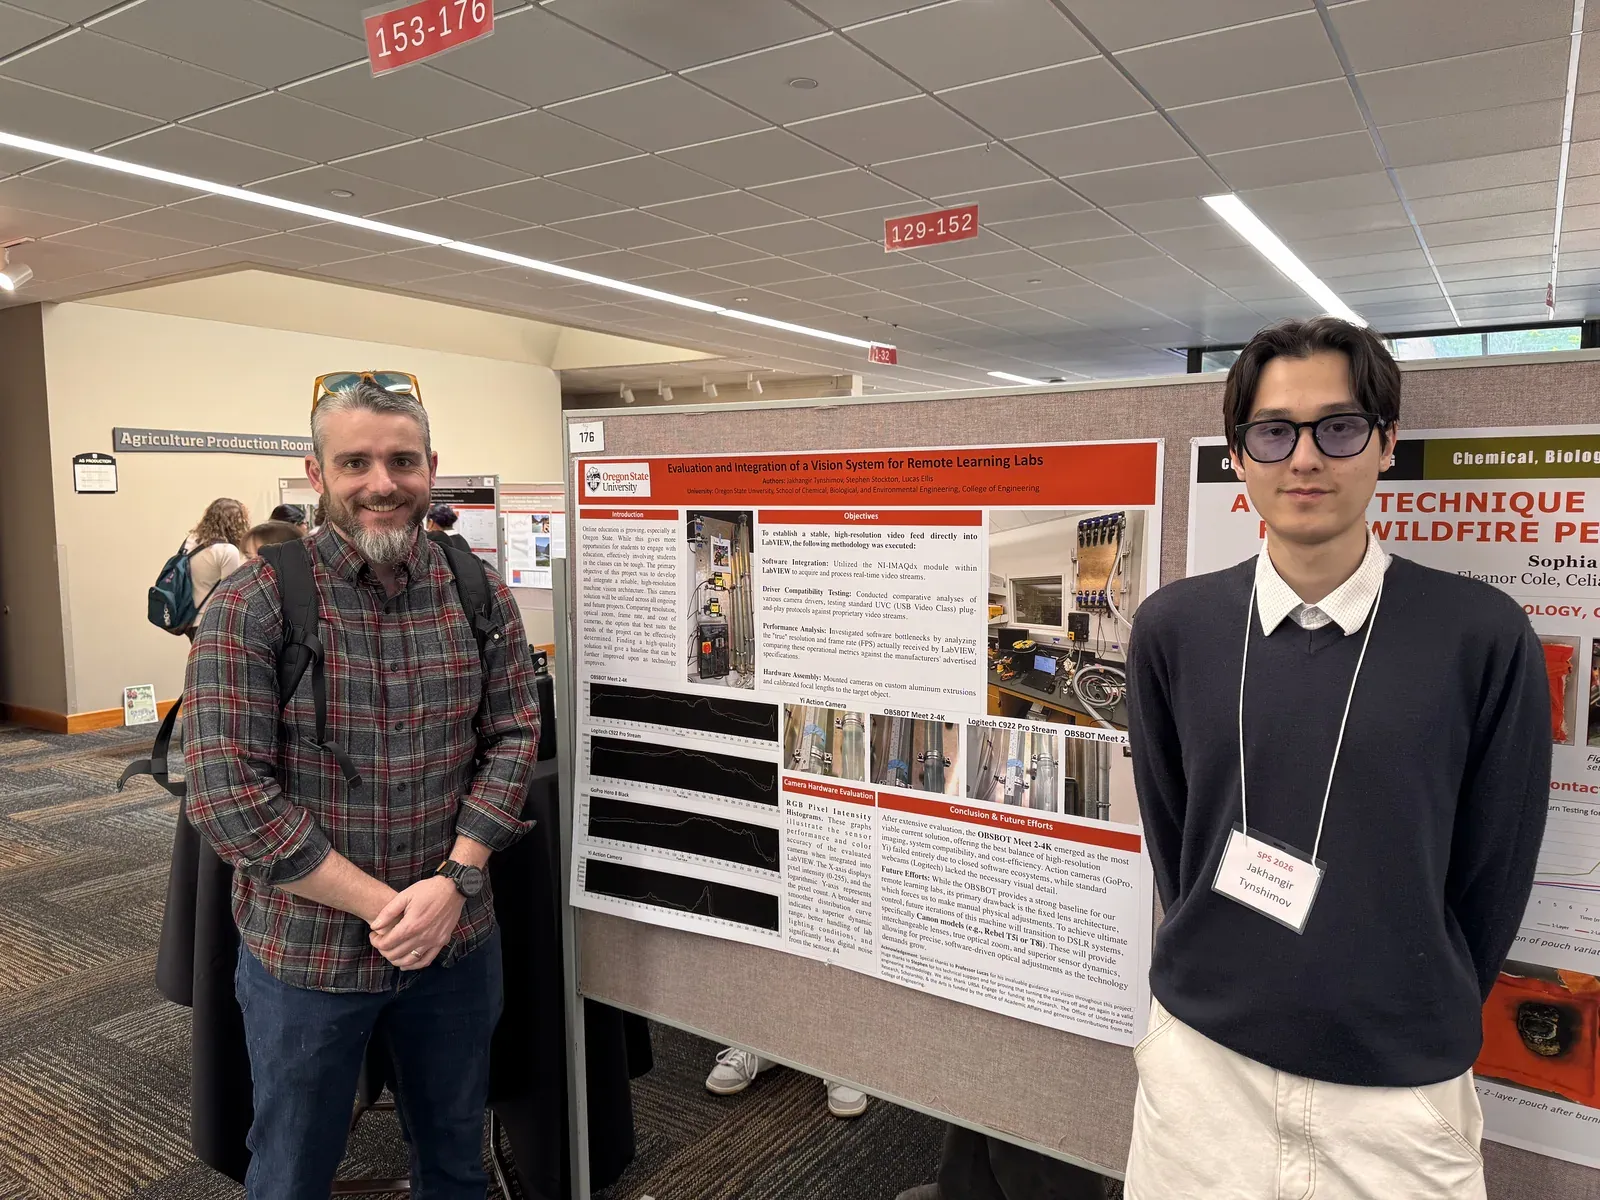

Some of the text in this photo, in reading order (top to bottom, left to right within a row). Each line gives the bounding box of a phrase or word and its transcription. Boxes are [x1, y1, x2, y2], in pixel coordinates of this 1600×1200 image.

[375, 0, 486, 58] 153-176
[892, 213, 972, 243] 129-152
[120, 432, 314, 451] Agriculture Production Room
[580, 432, 594, 443] 176
[668, 454, 1043, 474] Evaluation and Integration of a Vision System for Remote Learning Labs
[1453, 450, 1538, 465] Chemical,
[603, 472, 649, 483] Oregon State
[787, 477, 813, 485] Jakhangir
[814, 477, 844, 485] Tynshimov,
[846, 476, 870, 484] Stephen
[603, 482, 637, 494] University
[802, 487, 829, 495] Chemical,
[830, 487, 859, 495] Biological,
[920, 486, 960, 494] Engineering,
[962, 485, 987, 493] College
[998, 484, 1040, 493] Engineering
[1231, 491, 1585, 518] A TECHNIQUE
[844, 512, 879, 520] Objectives
[810, 531, 830, 539] stable,
[835, 531, 882, 540] high-resolution
[930, 533, 957, 541] directly
[1366, 521, 1600, 543] WILDFIRE PE
[762, 539, 792, 547] LabVIEW,
[802, 540, 830, 548] following
[831, 540, 869, 549] methodology
[1528, 555, 1597, 570] Sophia
[1521, 573, 1561, 587] Cole,
[825, 701, 847, 709] Camera
[884, 708, 910, 717] OBSBOT
[911, 711, 929, 720] Meet
[968, 718, 1058, 735] Logitech C922 Pro Stream
[1064, 729, 1096, 739] OBSBOT
[1098, 734, 1118, 742] Meet
[784, 779, 874, 800] Camera Hardware Evaluation
[1550, 781, 1600, 794] ontac
[786, 799, 803, 808] RGB
[809, 803, 828, 813] Pixel
[833, 808, 872, 821] Intensity
[787, 809, 824, 822] Histograms.
[1562, 806, 1589, 816] Testing
[950, 806, 1053, 831] Conclusion & Future Efforts
[882, 815, 1129, 866] After extensive evaluation, the OBSBOT Meet 2-4K emerged as the most
[1257, 851, 1294, 873] SPS 2026
[1247, 863, 1294, 890] Jakhangir
[1239, 877, 1292, 908] Tynshimov
[1541, 940, 1571, 950] pouch
[1484, 1089, 1518, 1102] 2-layer
[1519, 1099, 1548, 1111] pouch
[1550, 1107, 1574, 1117] after
